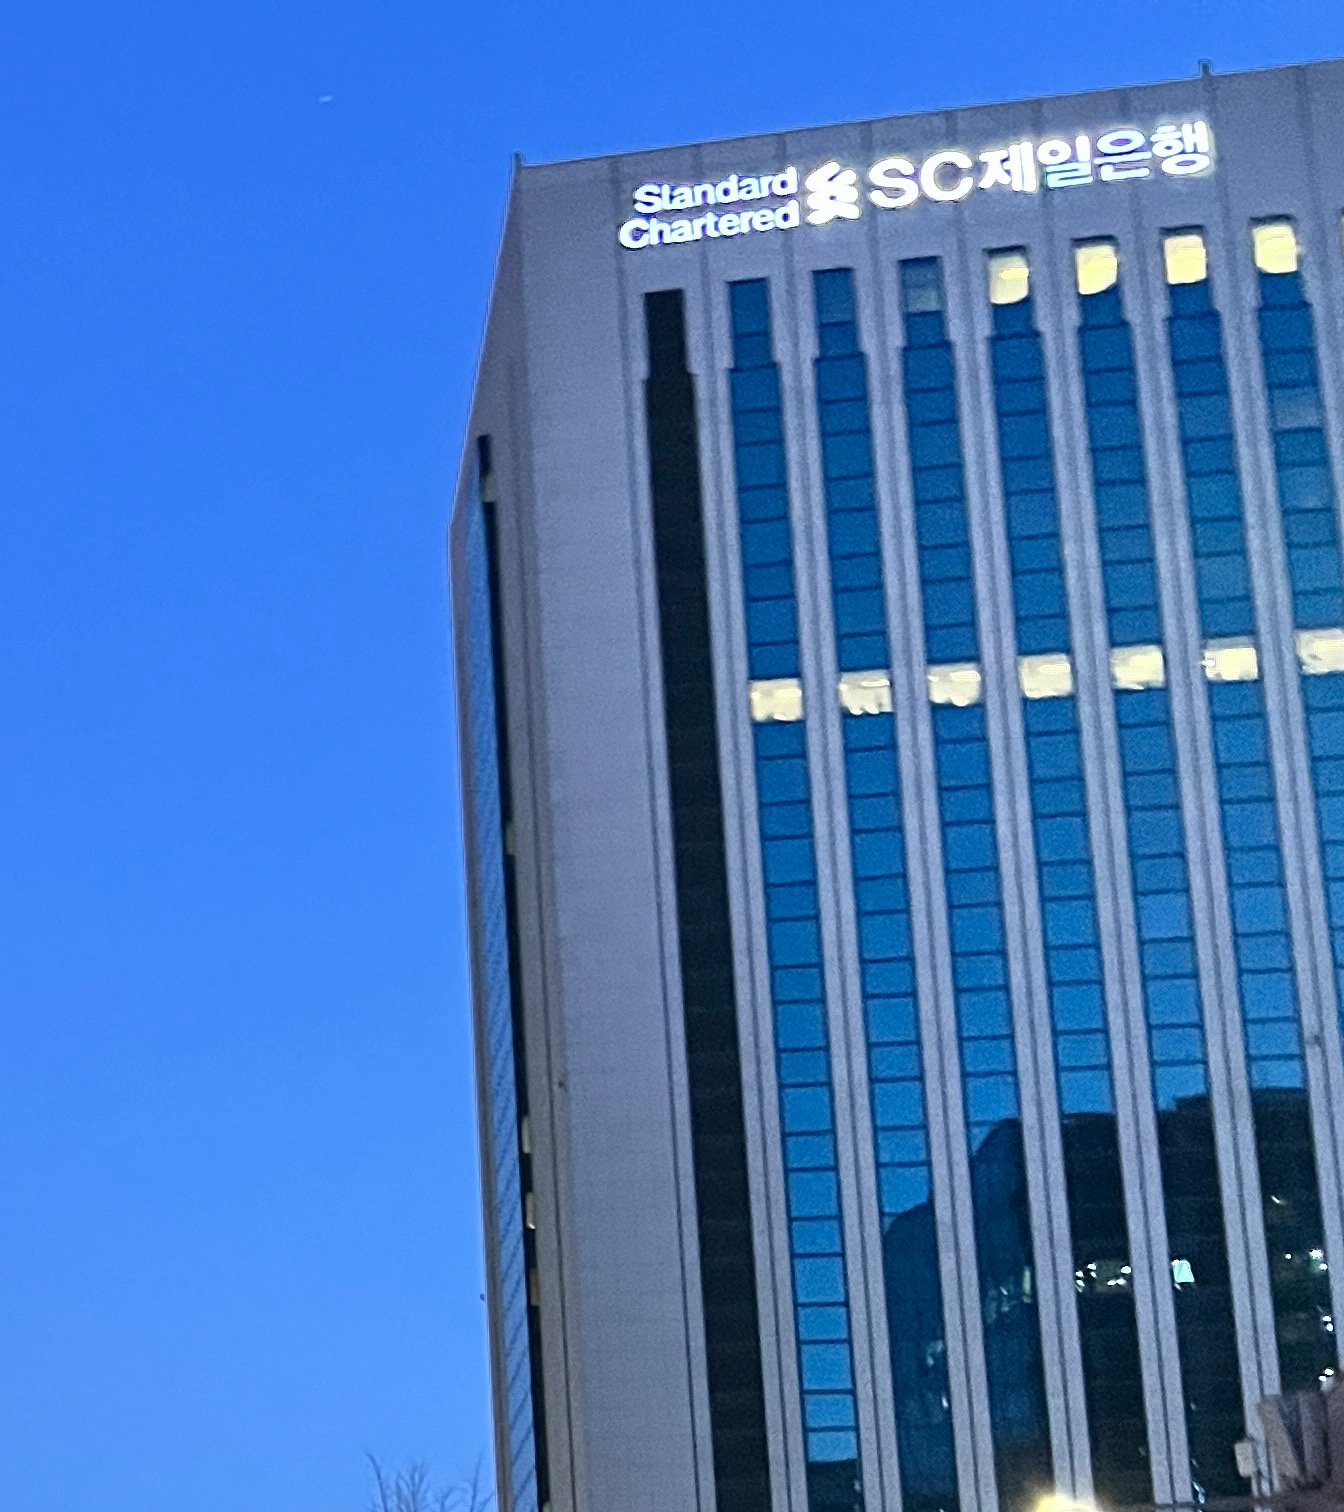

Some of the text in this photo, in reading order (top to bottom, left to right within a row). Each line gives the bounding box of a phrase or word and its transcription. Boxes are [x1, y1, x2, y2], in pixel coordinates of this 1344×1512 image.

[634, 165, 799, 214] Standard
[868, 119, 1211, 210] SC제일은행
[618, 200, 801, 250] Chartered
